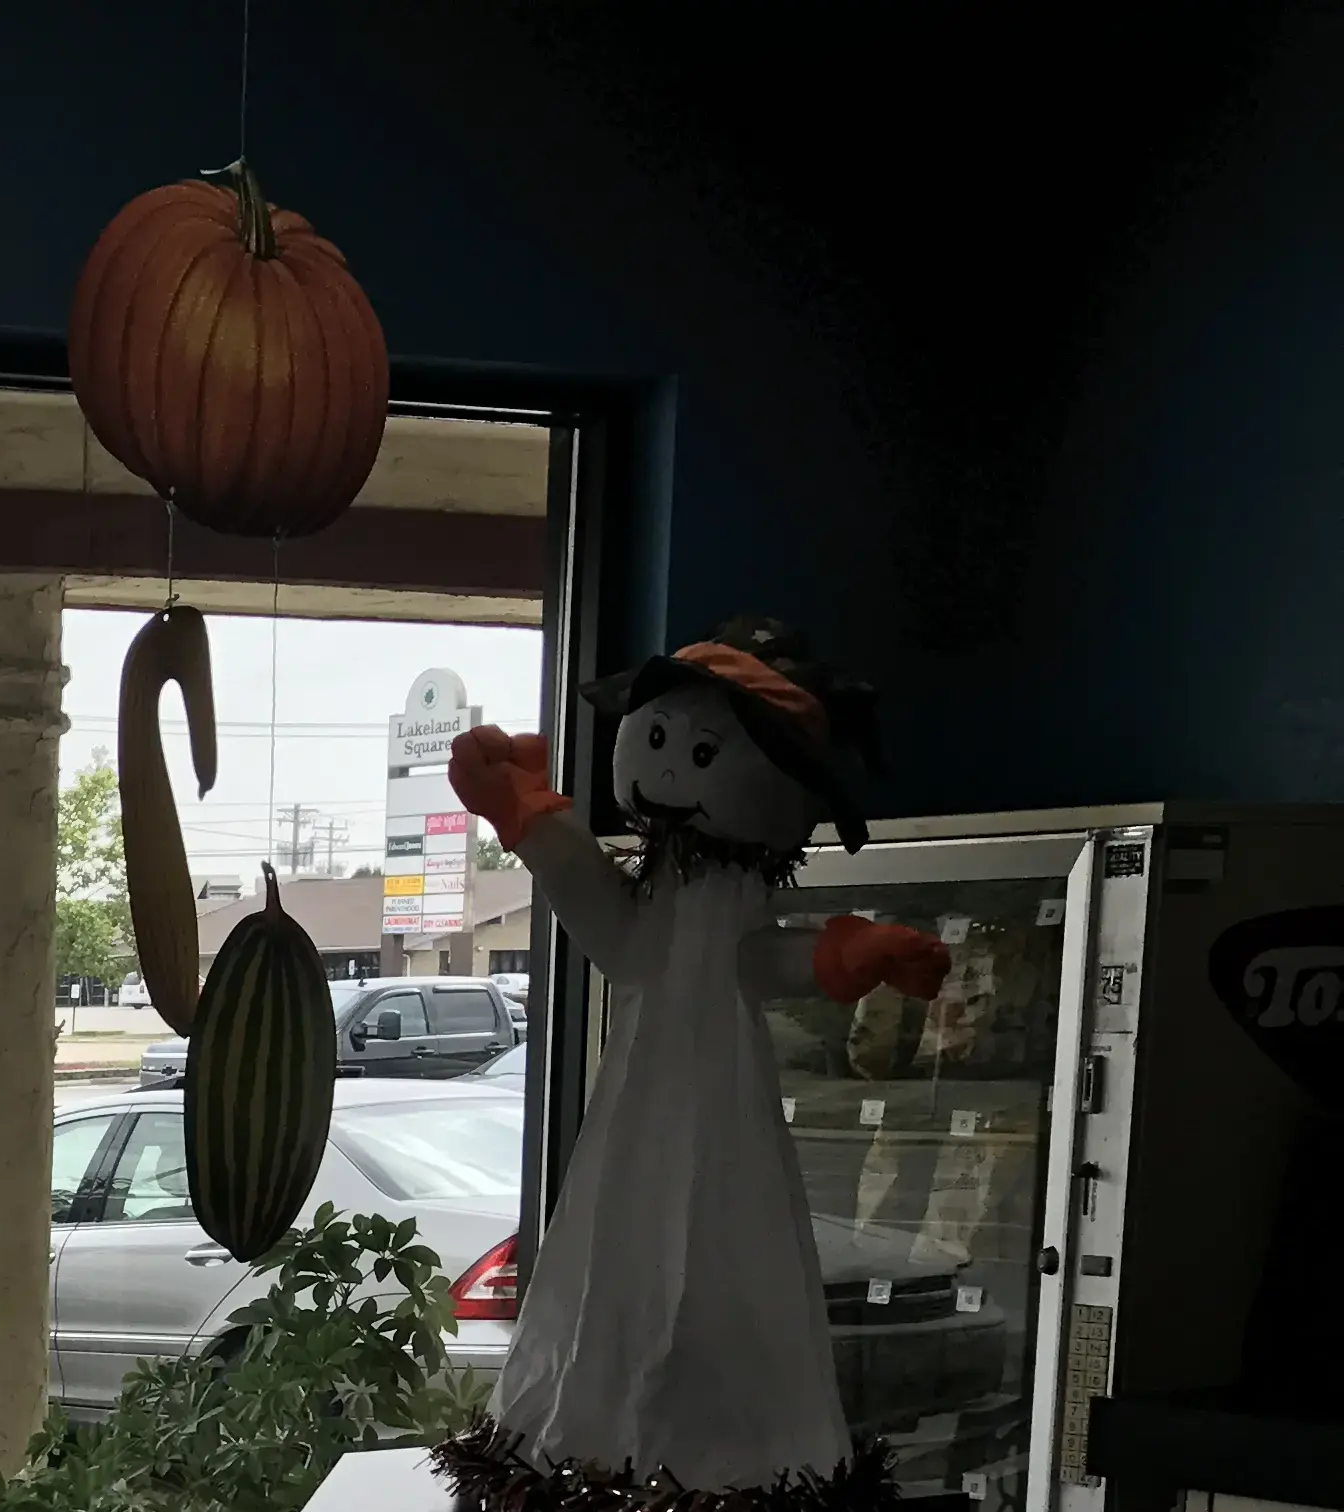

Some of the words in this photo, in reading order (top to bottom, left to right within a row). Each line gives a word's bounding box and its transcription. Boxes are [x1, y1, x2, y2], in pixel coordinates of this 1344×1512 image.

[396, 716, 461, 738] Lakeland
[405, 740, 452, 758] Square
[441, 876, 465, 890] Nails
[1243, 945, 1344, 1029] To
